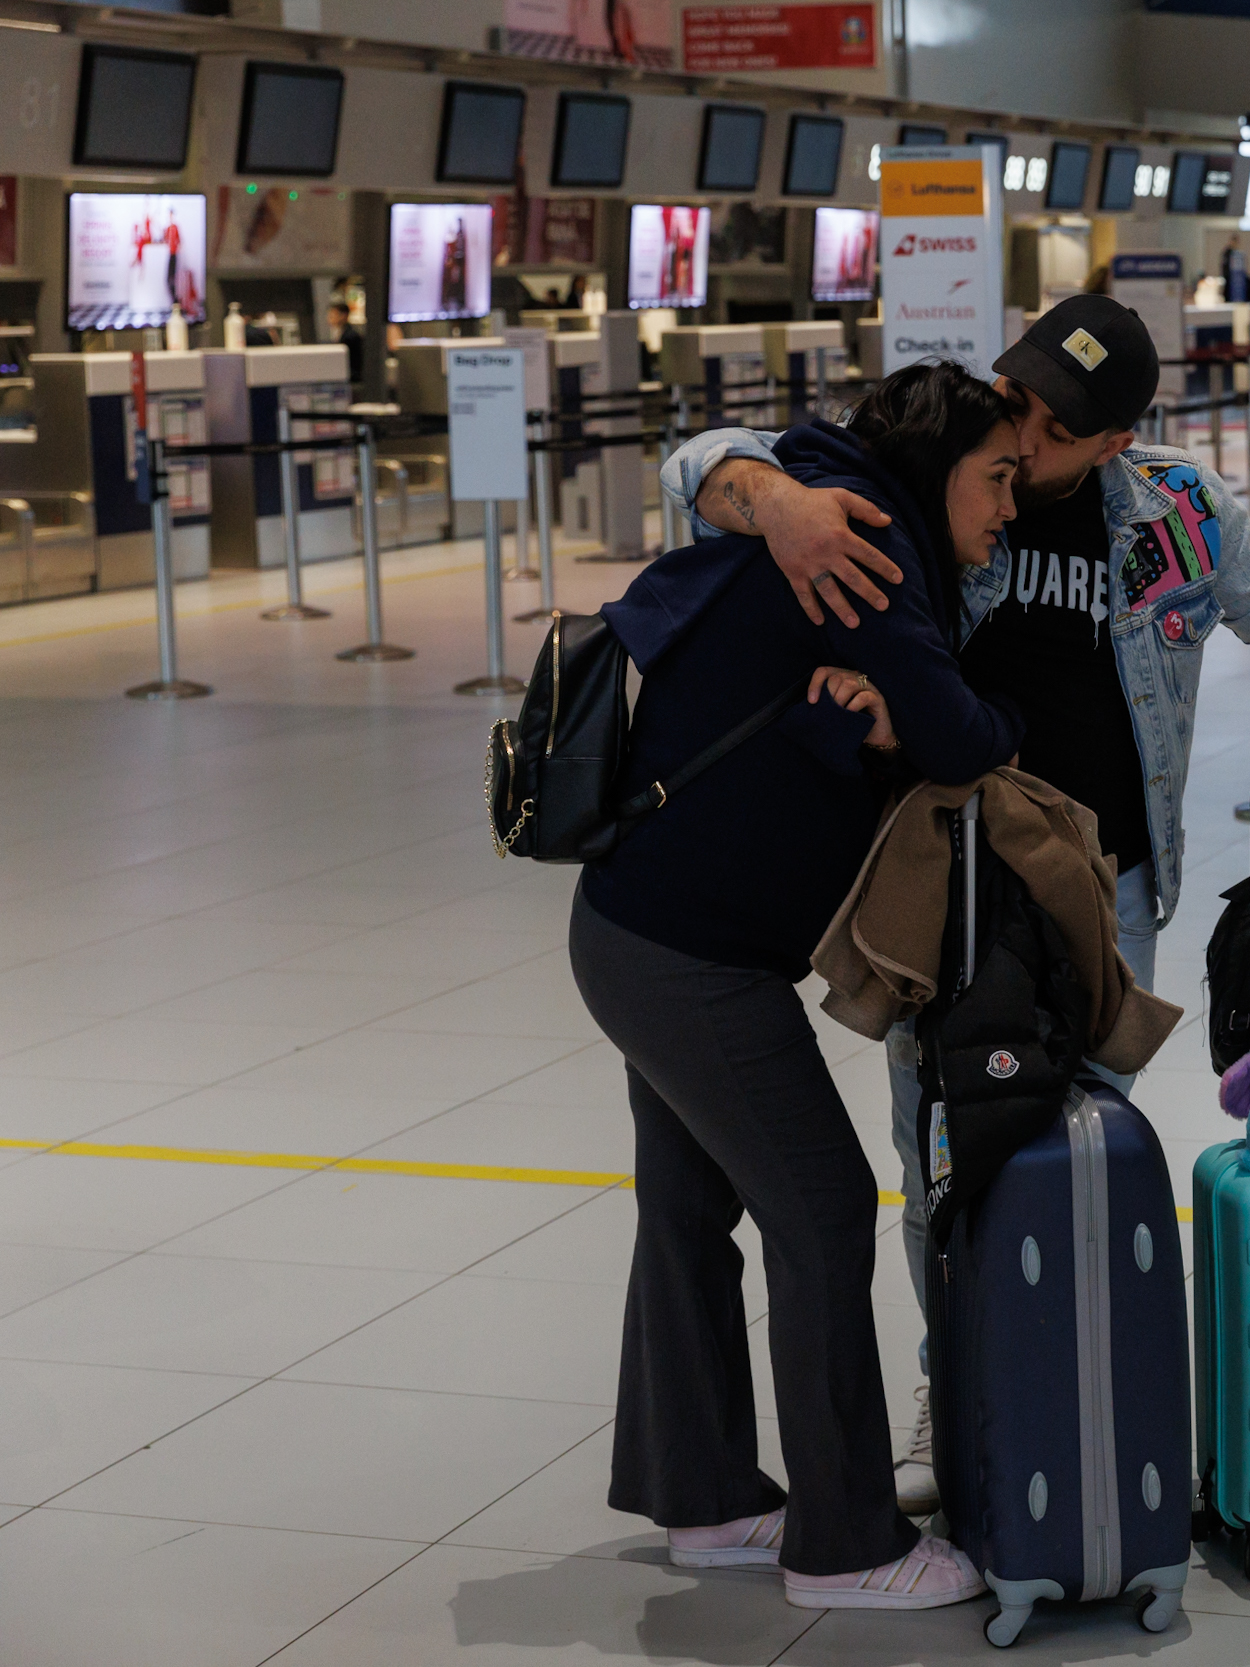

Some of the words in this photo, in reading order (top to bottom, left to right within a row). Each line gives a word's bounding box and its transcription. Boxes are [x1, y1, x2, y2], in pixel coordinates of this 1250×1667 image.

[910, 182, 977, 196] Lufthansa
[919, 236, 977, 253] SWISS
[895, 302, 976, 320] Austrian
[894, 336, 975, 354] Check-in
